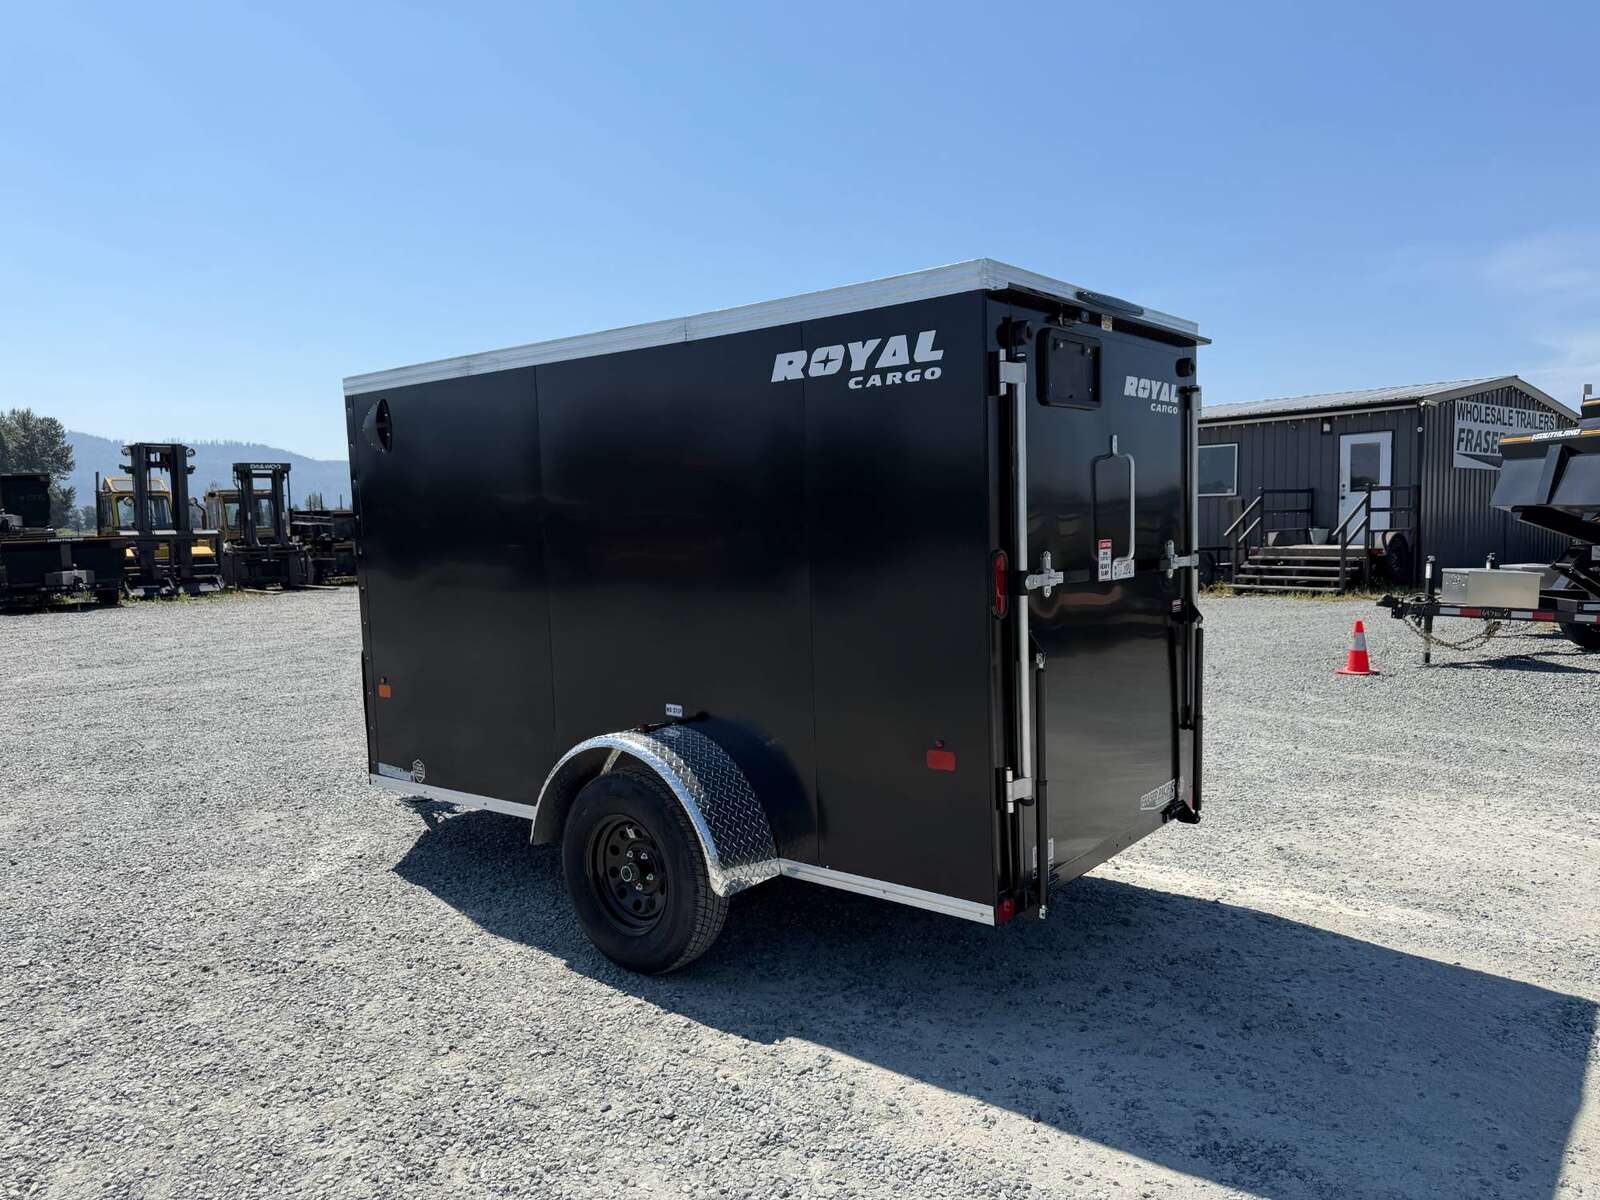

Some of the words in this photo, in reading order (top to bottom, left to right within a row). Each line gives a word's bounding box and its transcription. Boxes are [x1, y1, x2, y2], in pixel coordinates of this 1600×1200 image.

[771, 330, 944, 382] ROYAL
[848, 367, 942, 389] CARGO
[1123, 375, 1179, 403] ROYAL
[1150, 403, 1178, 414] CARGO
[1456, 401, 1513, 427] WHOLESALE
[1515, 411, 1555, 431] TRAILERS
